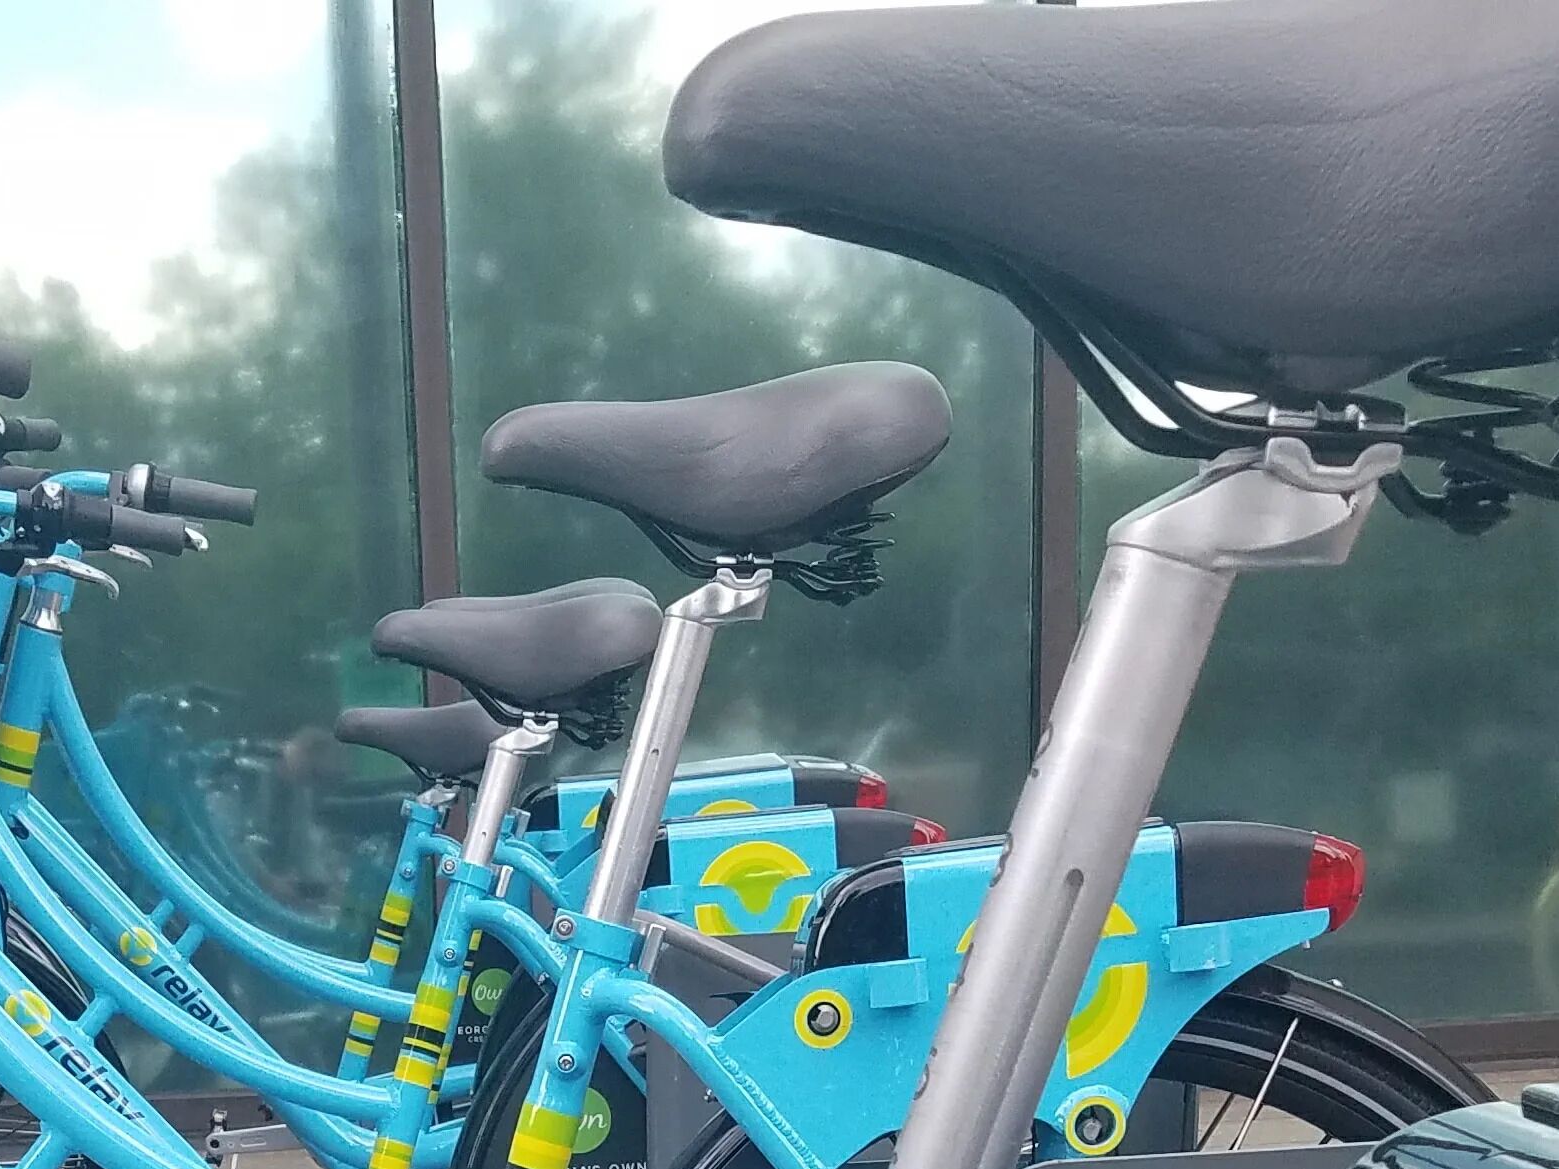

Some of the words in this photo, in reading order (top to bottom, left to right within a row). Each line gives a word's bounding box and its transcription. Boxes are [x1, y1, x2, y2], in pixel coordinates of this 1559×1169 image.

[150, 964, 232, 1034] relay
[474, 984, 503, 1001] Ow
[43, 1035, 145, 1121] relay
